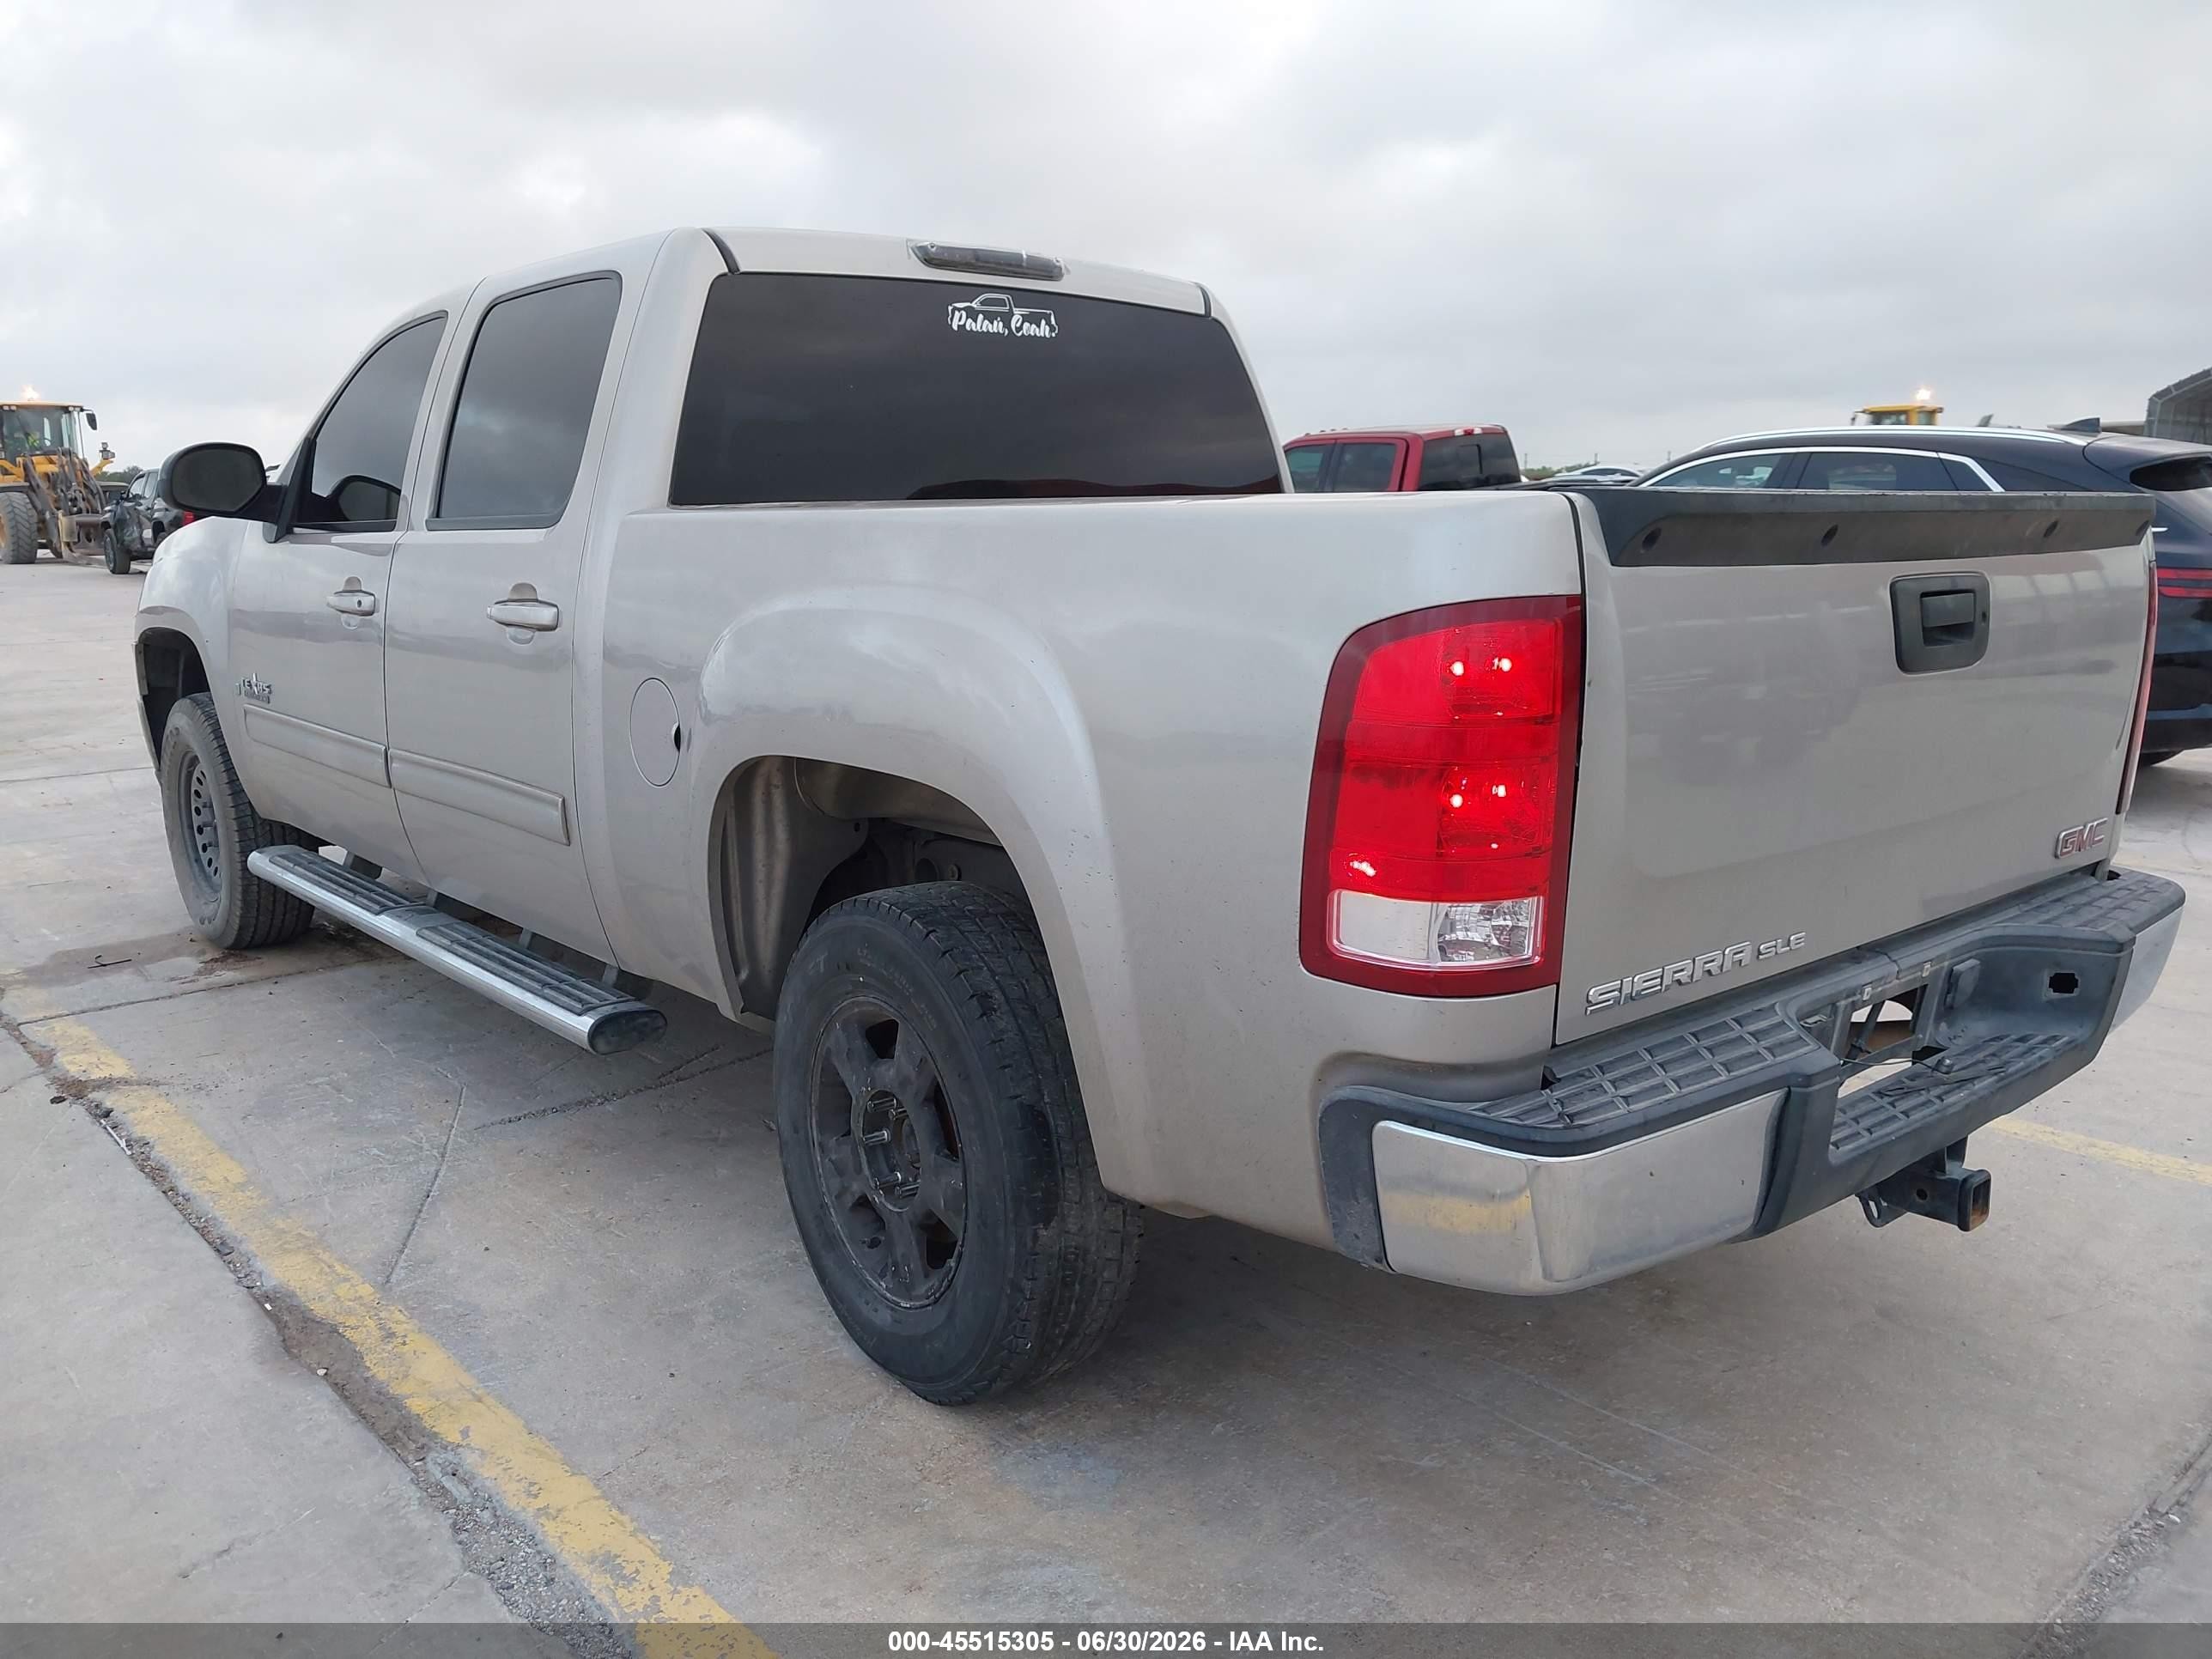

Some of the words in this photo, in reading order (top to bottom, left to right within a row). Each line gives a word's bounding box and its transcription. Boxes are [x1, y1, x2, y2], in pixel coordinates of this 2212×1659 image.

[2057, 817, 2108, 859] GMC
[1585, 940, 1752, 1016] SIERRA
[1758, 932, 1806, 960] SLE
